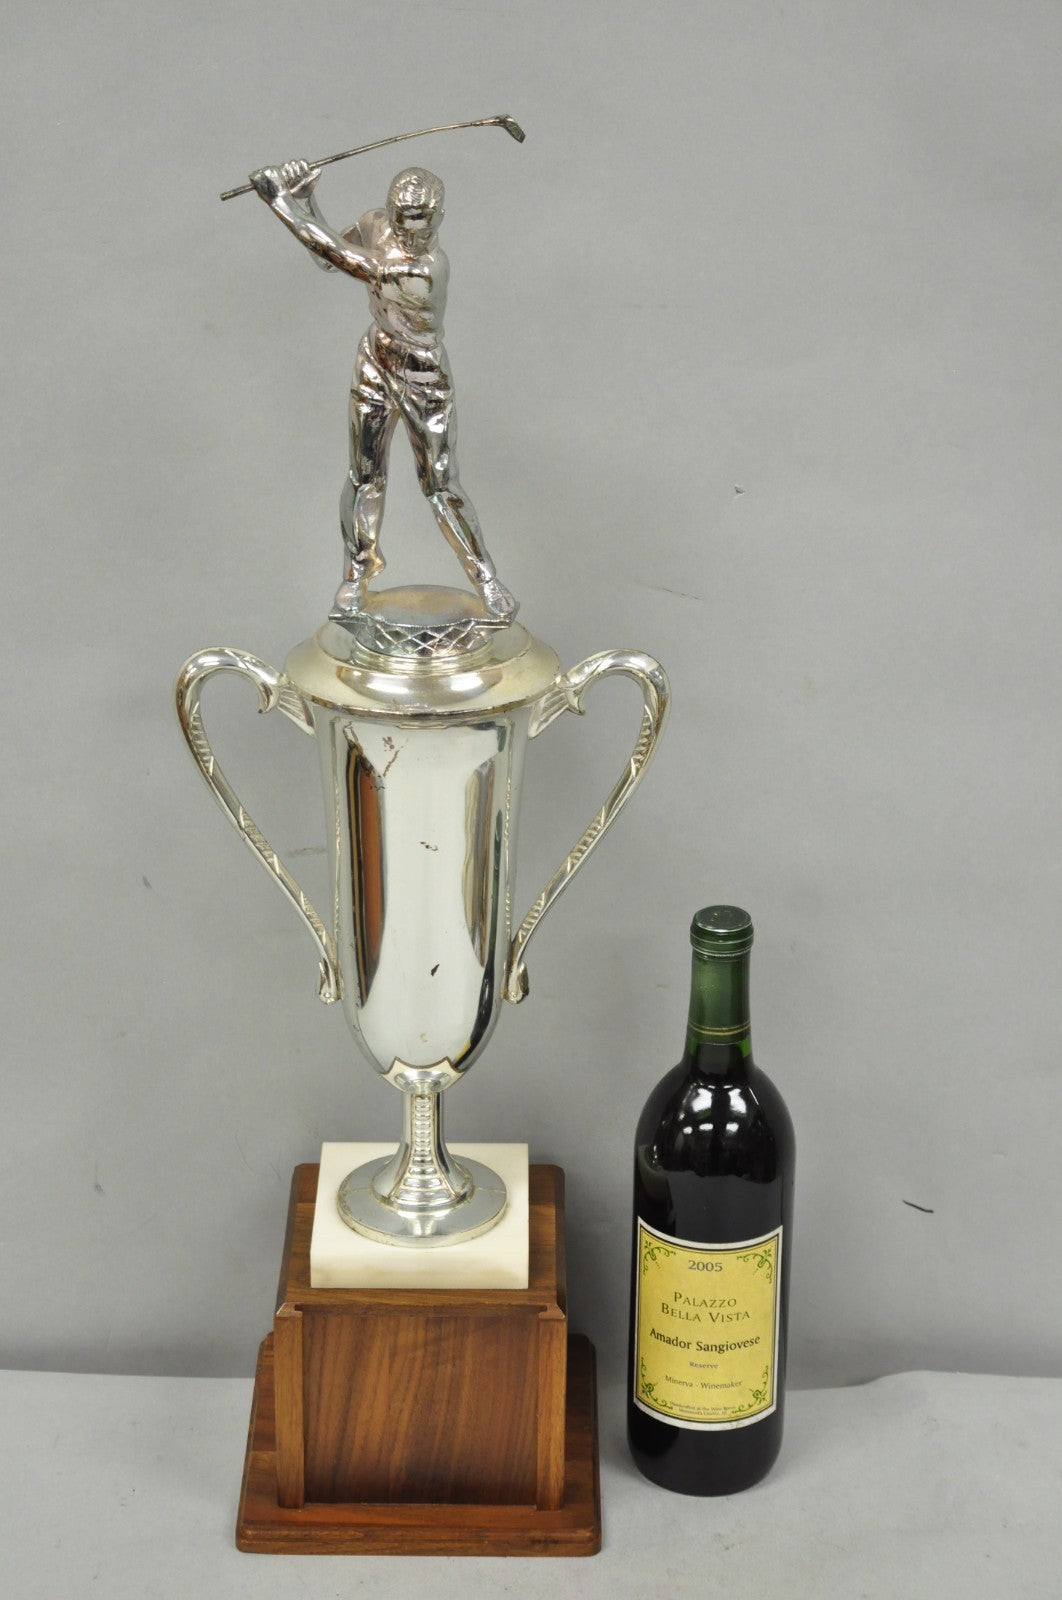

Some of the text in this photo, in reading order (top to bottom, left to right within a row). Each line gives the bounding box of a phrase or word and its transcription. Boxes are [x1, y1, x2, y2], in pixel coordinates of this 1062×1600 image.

[688, 1260, 723, 1272] 2005
[674, 1291, 737, 1308] PALAZZO
[661, 1302, 750, 1323] BELLA VISTA
[650, 1328, 761, 1354] Amador Sangiovese
[689, 1361, 718, 1369] Reserve
[665, 1374, 694, 1388] Minerva
[700, 1380, 743, 1390] Winemaker
